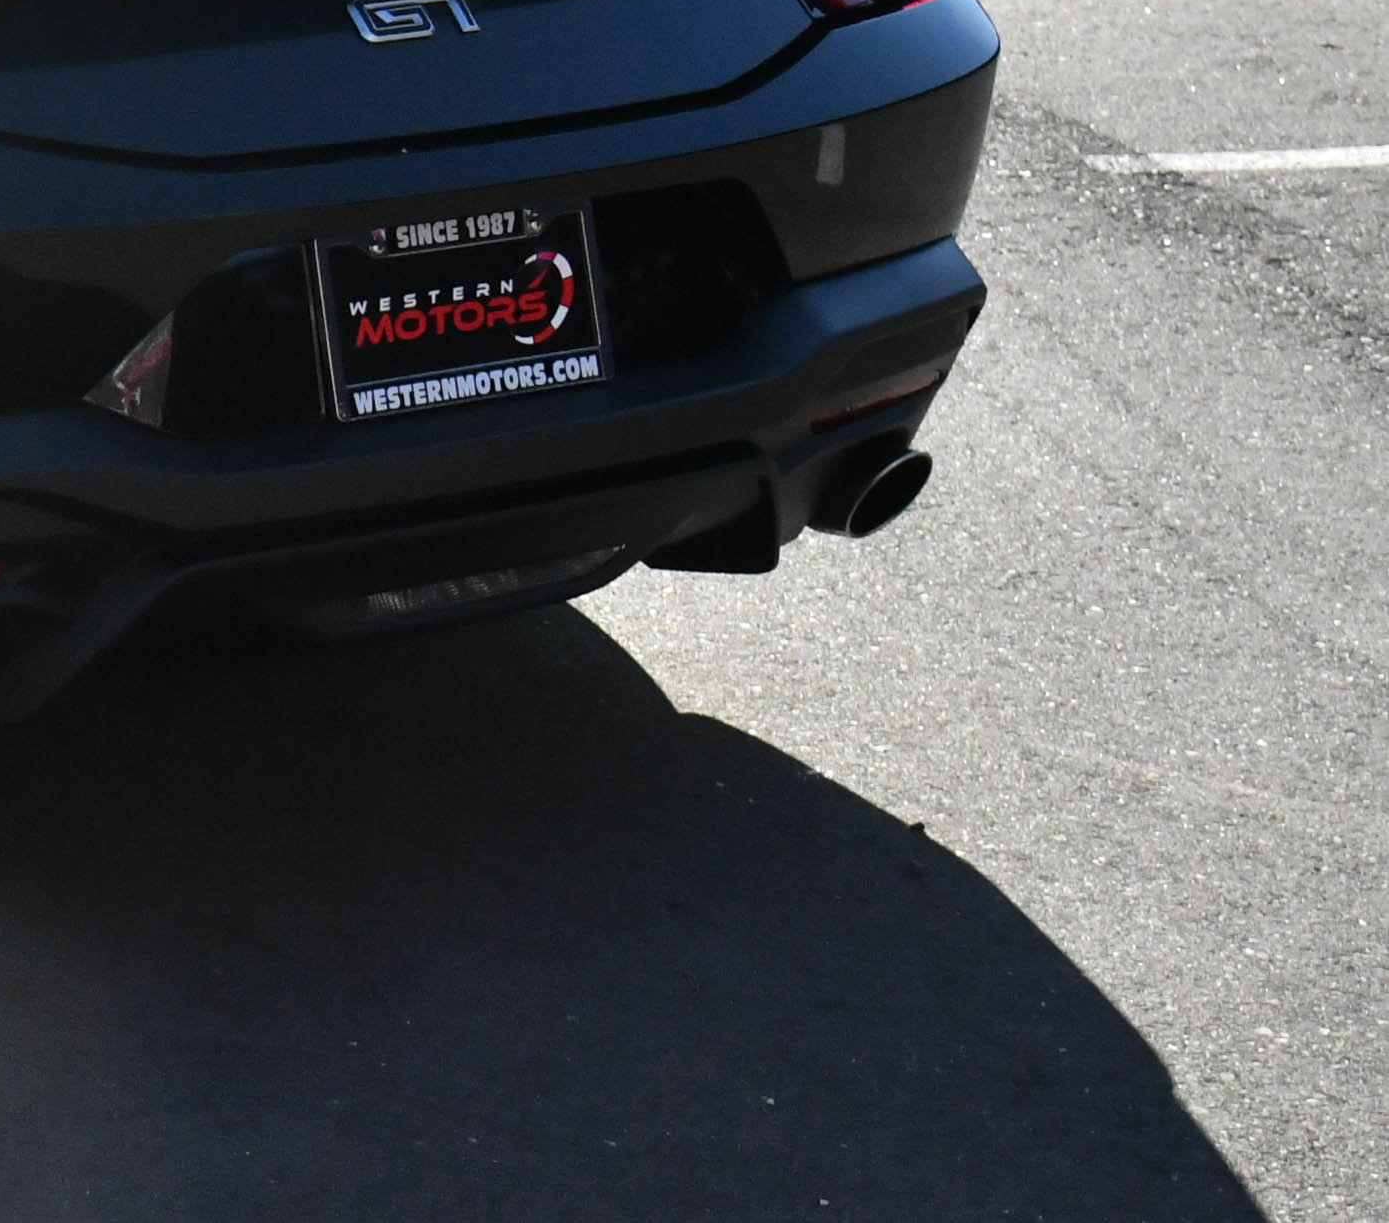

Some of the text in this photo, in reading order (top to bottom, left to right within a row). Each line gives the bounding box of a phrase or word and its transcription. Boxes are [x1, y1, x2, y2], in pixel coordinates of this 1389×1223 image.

[395, 211, 516, 249] SINCE 1987
[349, 279, 514, 316] WESTERN
[355, 290, 549, 348] MOTORS
[353, 354, 600, 416] WESTERNMOTORS.COM
